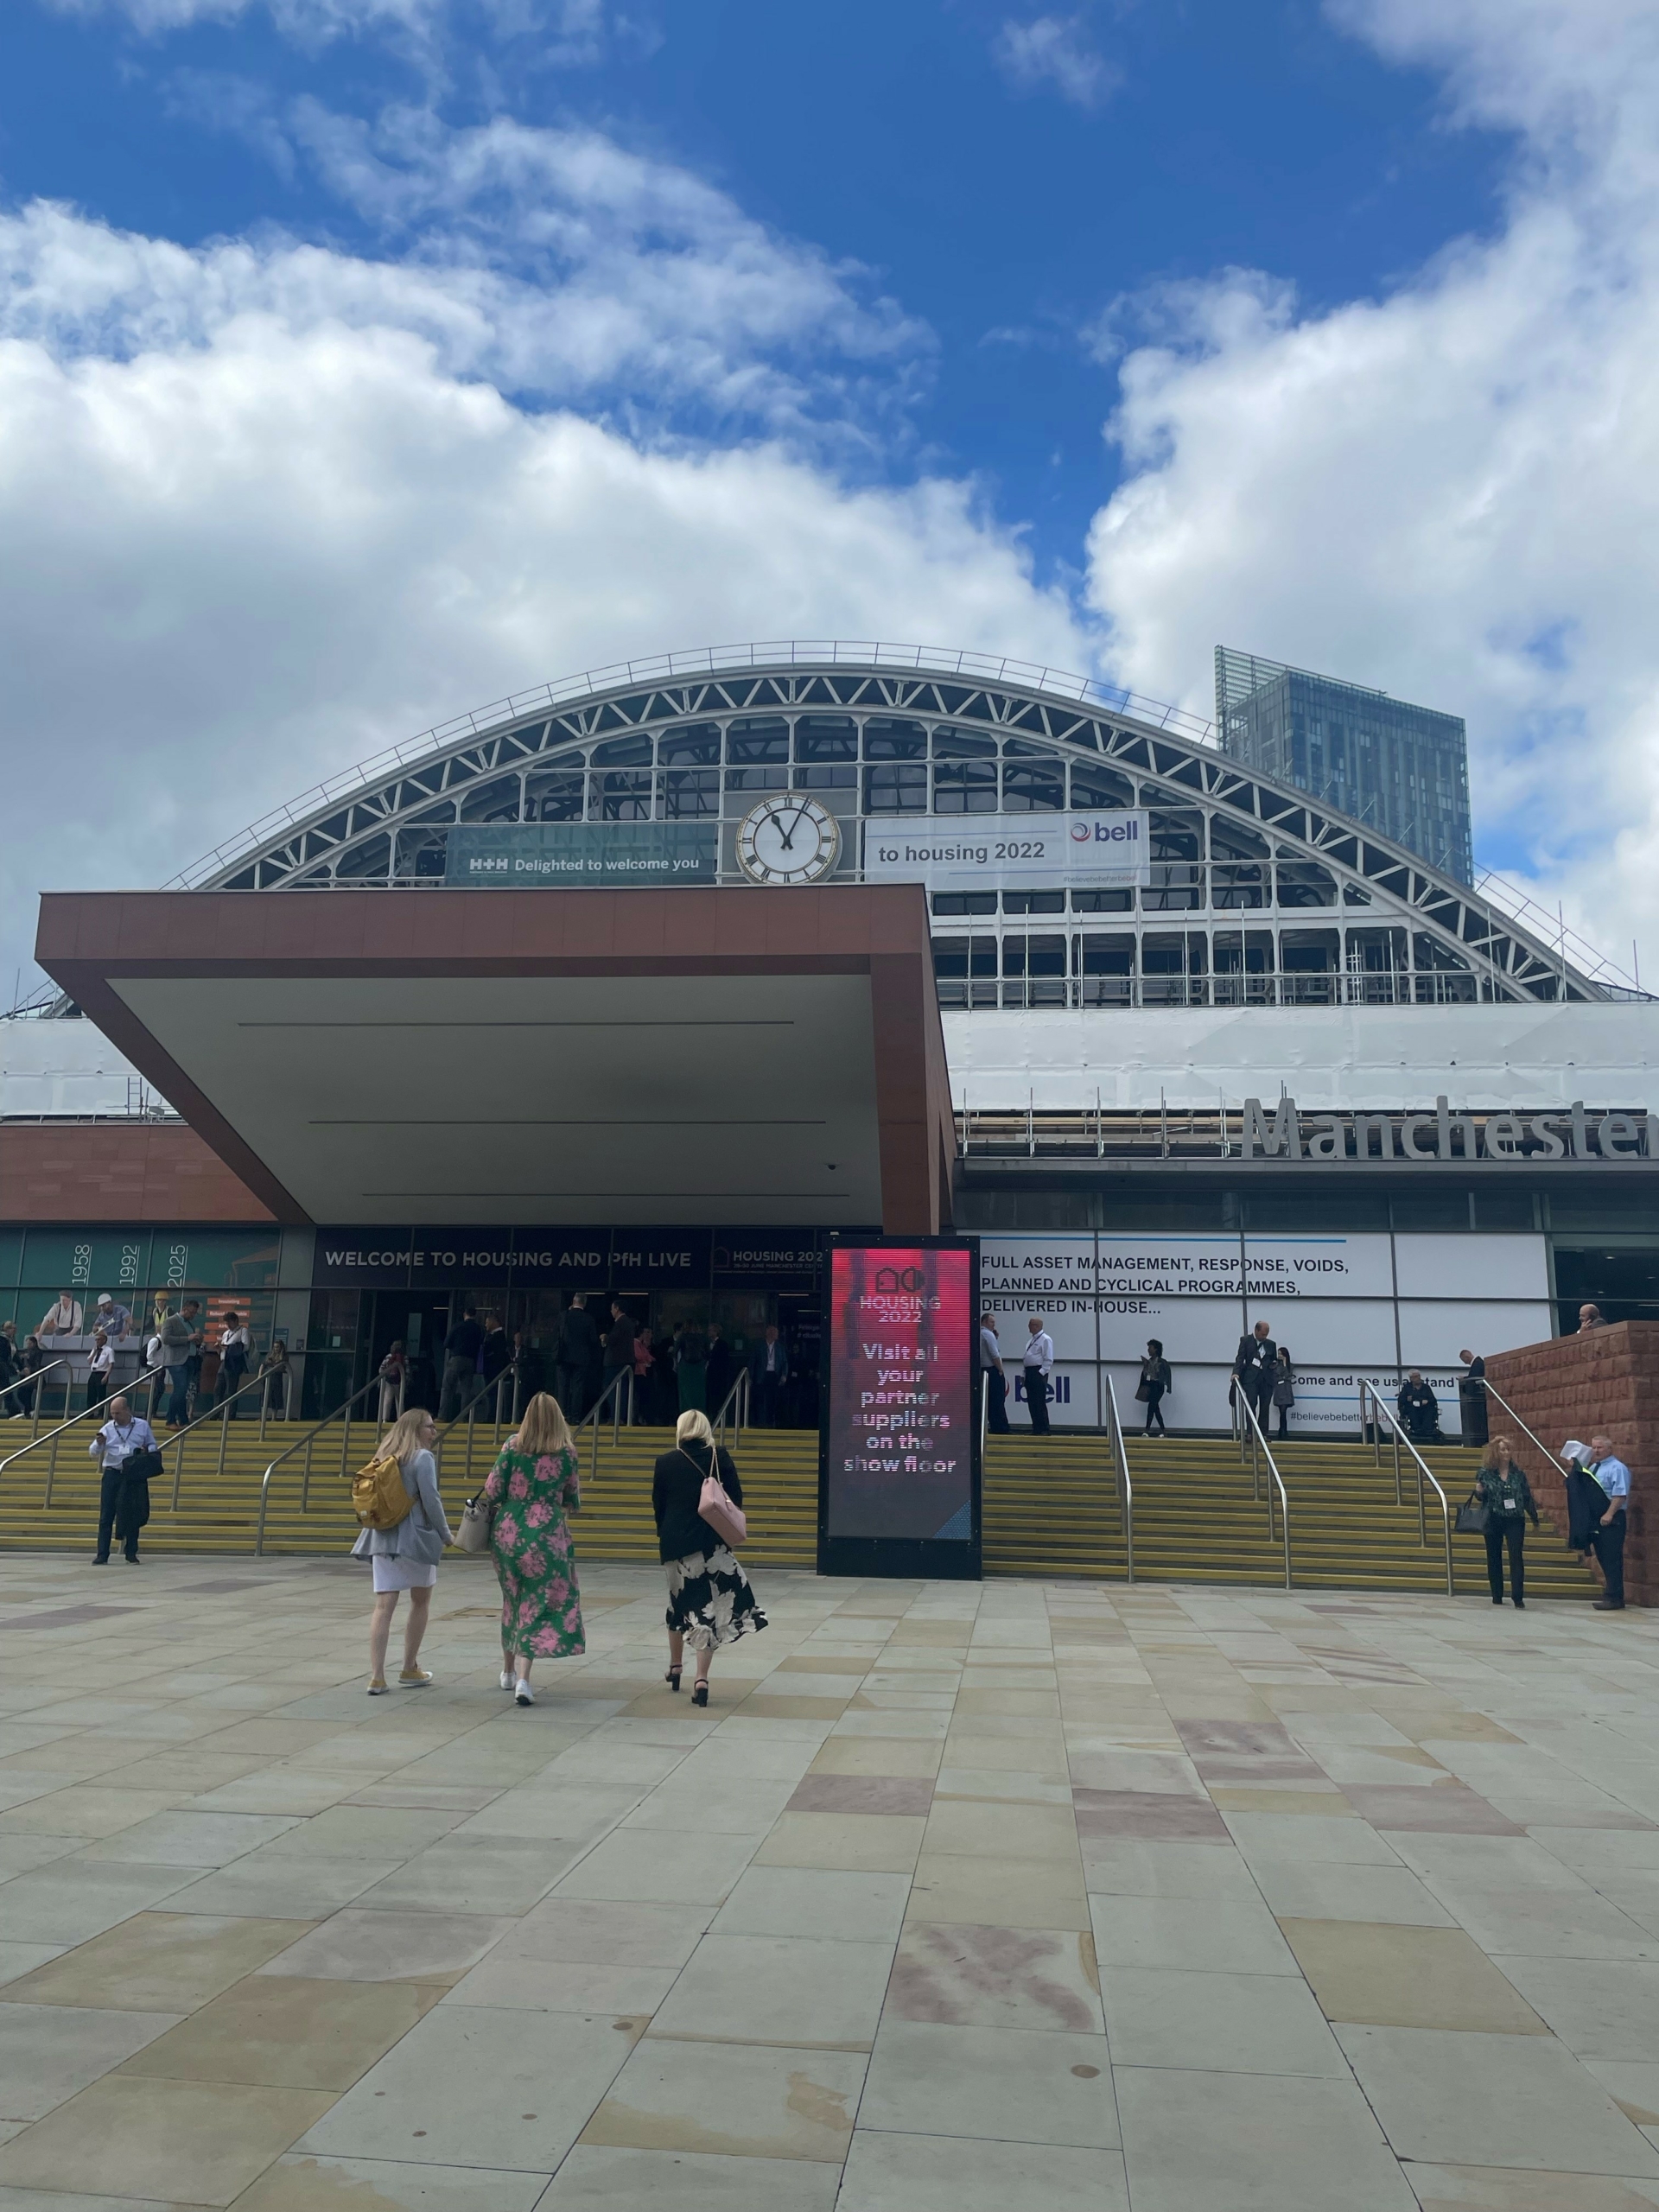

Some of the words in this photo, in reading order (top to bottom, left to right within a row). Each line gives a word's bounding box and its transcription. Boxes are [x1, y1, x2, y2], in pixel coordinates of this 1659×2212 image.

[1094, 820, 1138, 842] bell
[878, 846, 899, 862] to
[906, 843, 988, 863] housing
[994, 842, 1045, 860] 2022
[515, 858, 583, 874] Delighted
[587, 859, 602, 871] to
[606, 858, 669, 871] welcome
[671, 859, 699, 872] you
[71, 1244, 90, 1284] 1958
[119, 1244, 137, 1285] 1992
[325, 1251, 424, 1267] WELCOME
[431, 1252, 456, 1267] TO
[463, 1251, 553, 1267] HOUSING
[558, 1252, 601, 1267] AND
[648, 1252, 691, 1268] LIVE
[734, 1250, 794, 1262] HOUSING
[798, 1251, 823, 1262] 202
[981, 1256, 1019, 1268] FULL
[1023, 1256, 1073, 1269] ASSET
[1077, 1257, 1194, 1272] MANAGEMENT,
[1198, 1258, 1289, 1274] RESPONSE,
[1294, 1259, 1349, 1274] VOIDS,
[167, 1244, 186, 1287] 2025
[982, 1277, 1054, 1290] PLANNED
[1058, 1278, 1091, 1291] AND
[1097, 1279, 1173, 1292] CYCLICAL
[1178, 1280, 1300, 1296] PROGRAMMES,
[860, 1295, 942, 1310] HOUSING
[982, 1299, 1067, 1313] DELIVERED
[1071, 1300, 1161, 1314] IN-HOUSE...
[878, 1311, 922, 1323] 2022
[862, 1344, 911, 1360] Visit
[914, 1344, 938, 1362] all
[876, 1370, 924, 1386] your
[1289, 1374, 1325, 1385] Come
[1329, 1375, 1353, 1386] and
[1383, 1377, 1398, 1387] us
[1425, 1376, 1454, 1388] tand
[861, 1390, 940, 1408] partner
[852, 1410, 950, 1431] suppliers
[866, 1436, 893, 1450] on
[898, 1433, 934, 1451] the
[843, 1454, 900, 1471] show
[904, 1455, 957, 1472] floor
